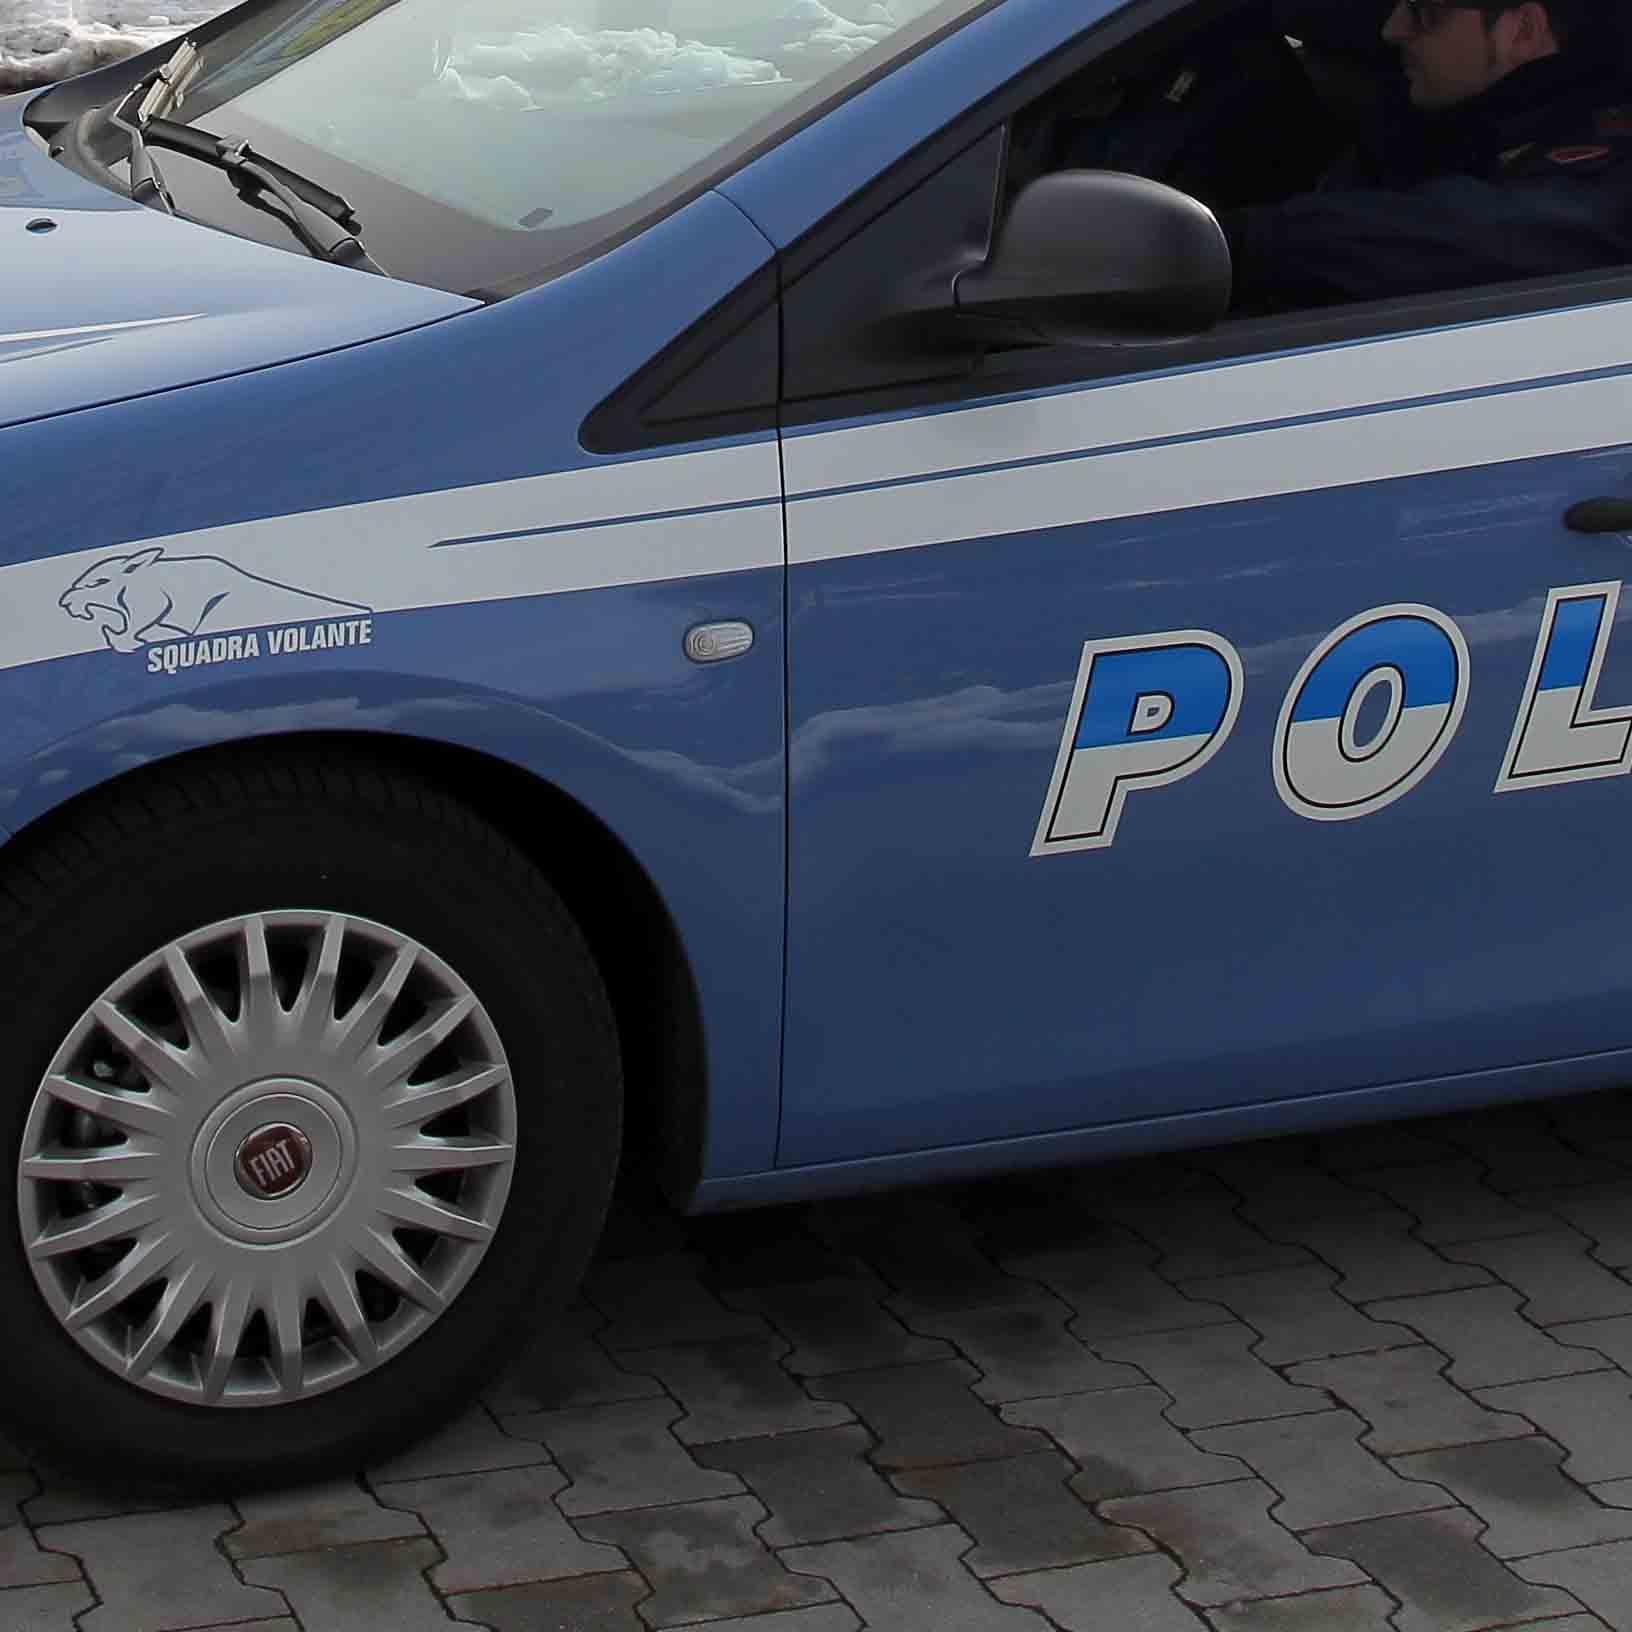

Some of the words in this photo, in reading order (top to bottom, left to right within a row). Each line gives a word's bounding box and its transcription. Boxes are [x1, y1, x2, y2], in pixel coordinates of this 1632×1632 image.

[147, 633, 260, 675] SQUADRA
[267, 619, 373, 655] VOLANTE
[249, 1139, 296, 1186] FIAT
